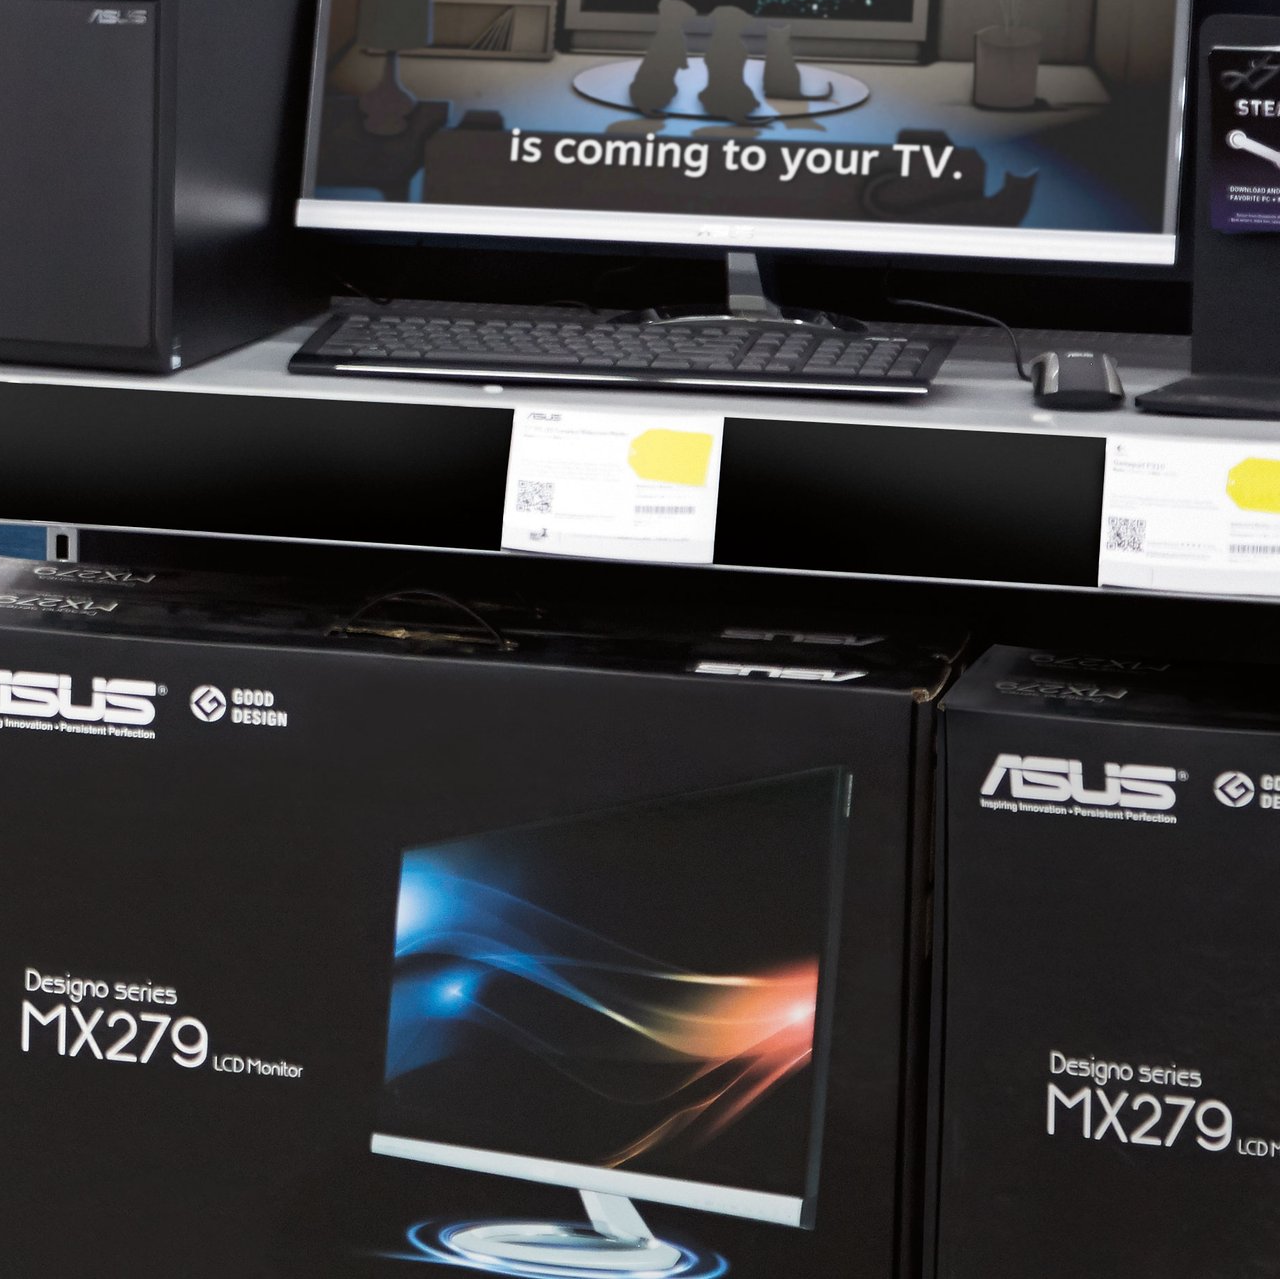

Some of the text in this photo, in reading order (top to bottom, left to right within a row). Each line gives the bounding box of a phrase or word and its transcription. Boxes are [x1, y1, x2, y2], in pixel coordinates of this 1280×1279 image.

[90, 9, 148, 24] ASUS
[510, 128, 962, 182] is coming to your TV.
[1230, 186, 1265, 195] DOWNLOAD
[1230, 194, 1259, 203] FAVORITE
[232, 689, 274, 707] GOOD
[5, 718, 53, 733] Innovation
[60, 722, 106, 737] Persistent
[108, 724, 156, 739] Perfection
[232, 707, 288, 728] DESIGN
[981, 753, 1177, 811] ASUS
[25, 968, 178, 1007] Designo series
[20, 1000, 303, 1079] MX279 LCD Monitor
[1050, 1050, 1202, 1089] Designo series
[1047, 1083, 1268, 1158] MX279 LCD
